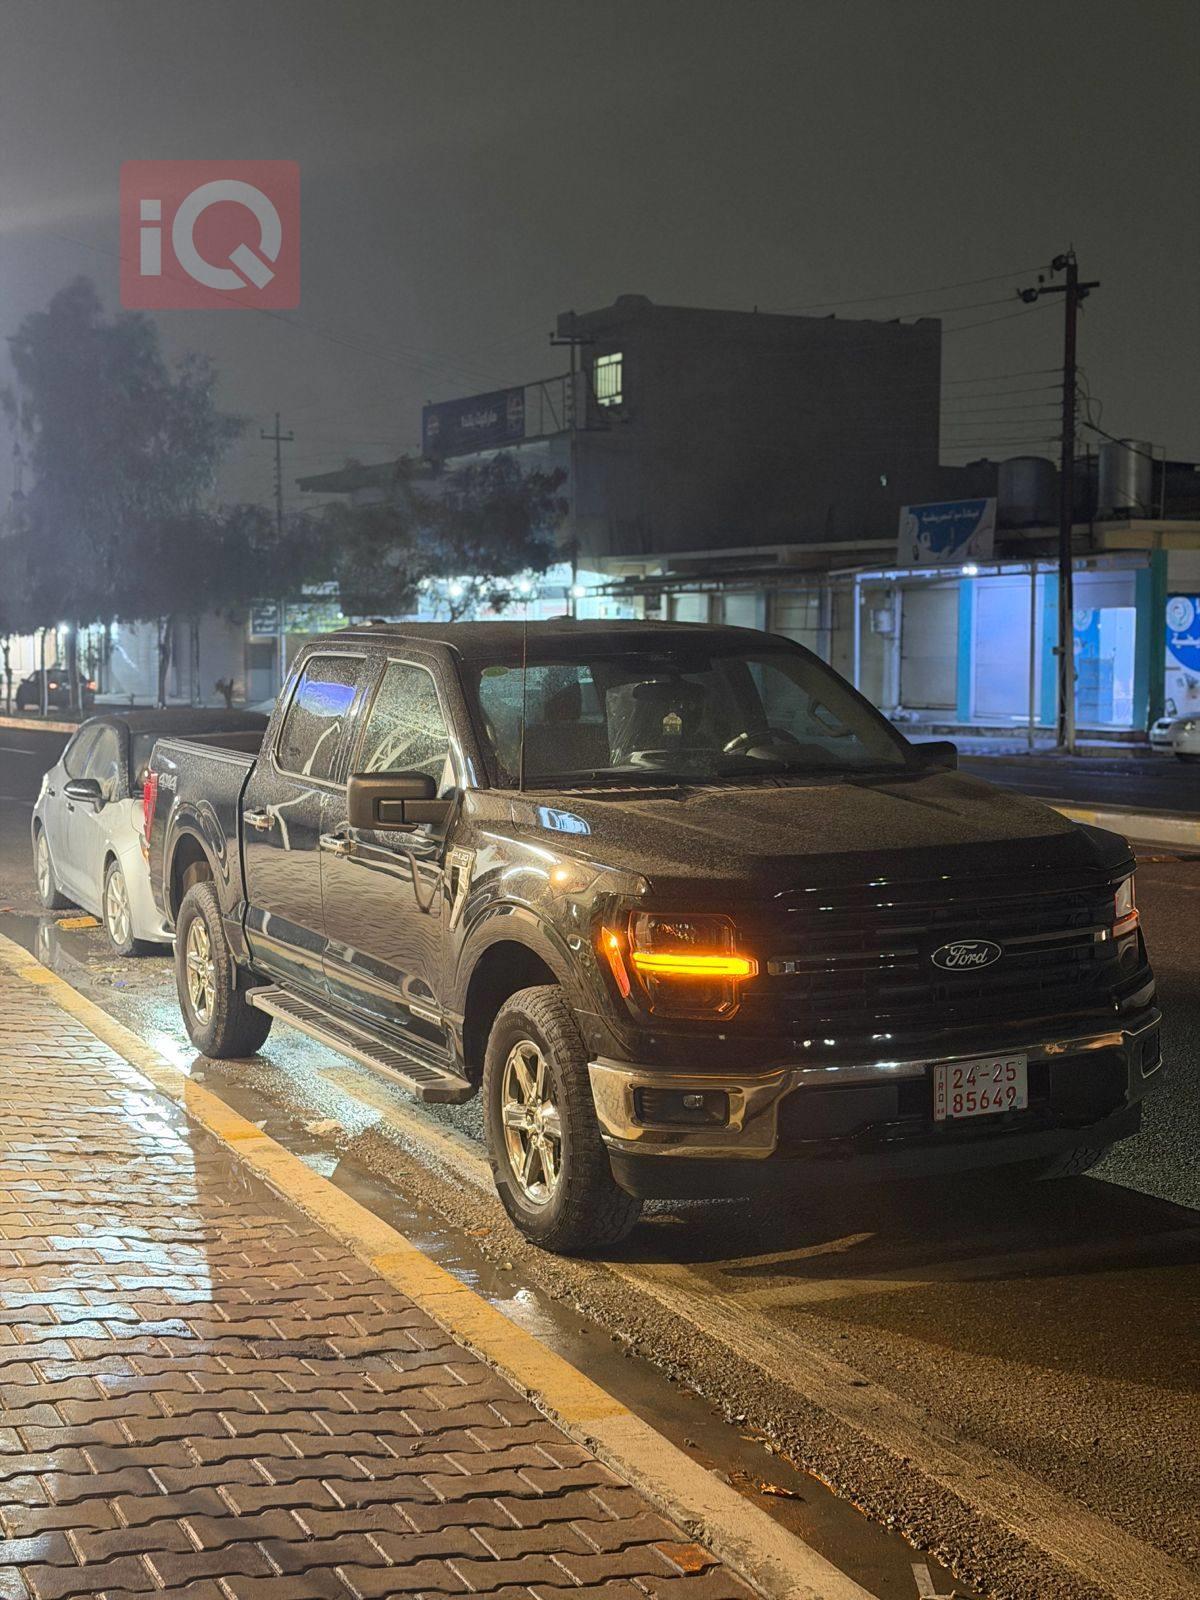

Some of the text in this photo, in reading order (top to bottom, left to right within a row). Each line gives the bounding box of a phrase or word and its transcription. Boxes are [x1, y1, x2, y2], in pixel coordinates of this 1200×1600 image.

[946, 944, 988, 967] Ford
[953, 1062, 1016, 1089] 24-25
[953, 1086, 1017, 1114] 85649
